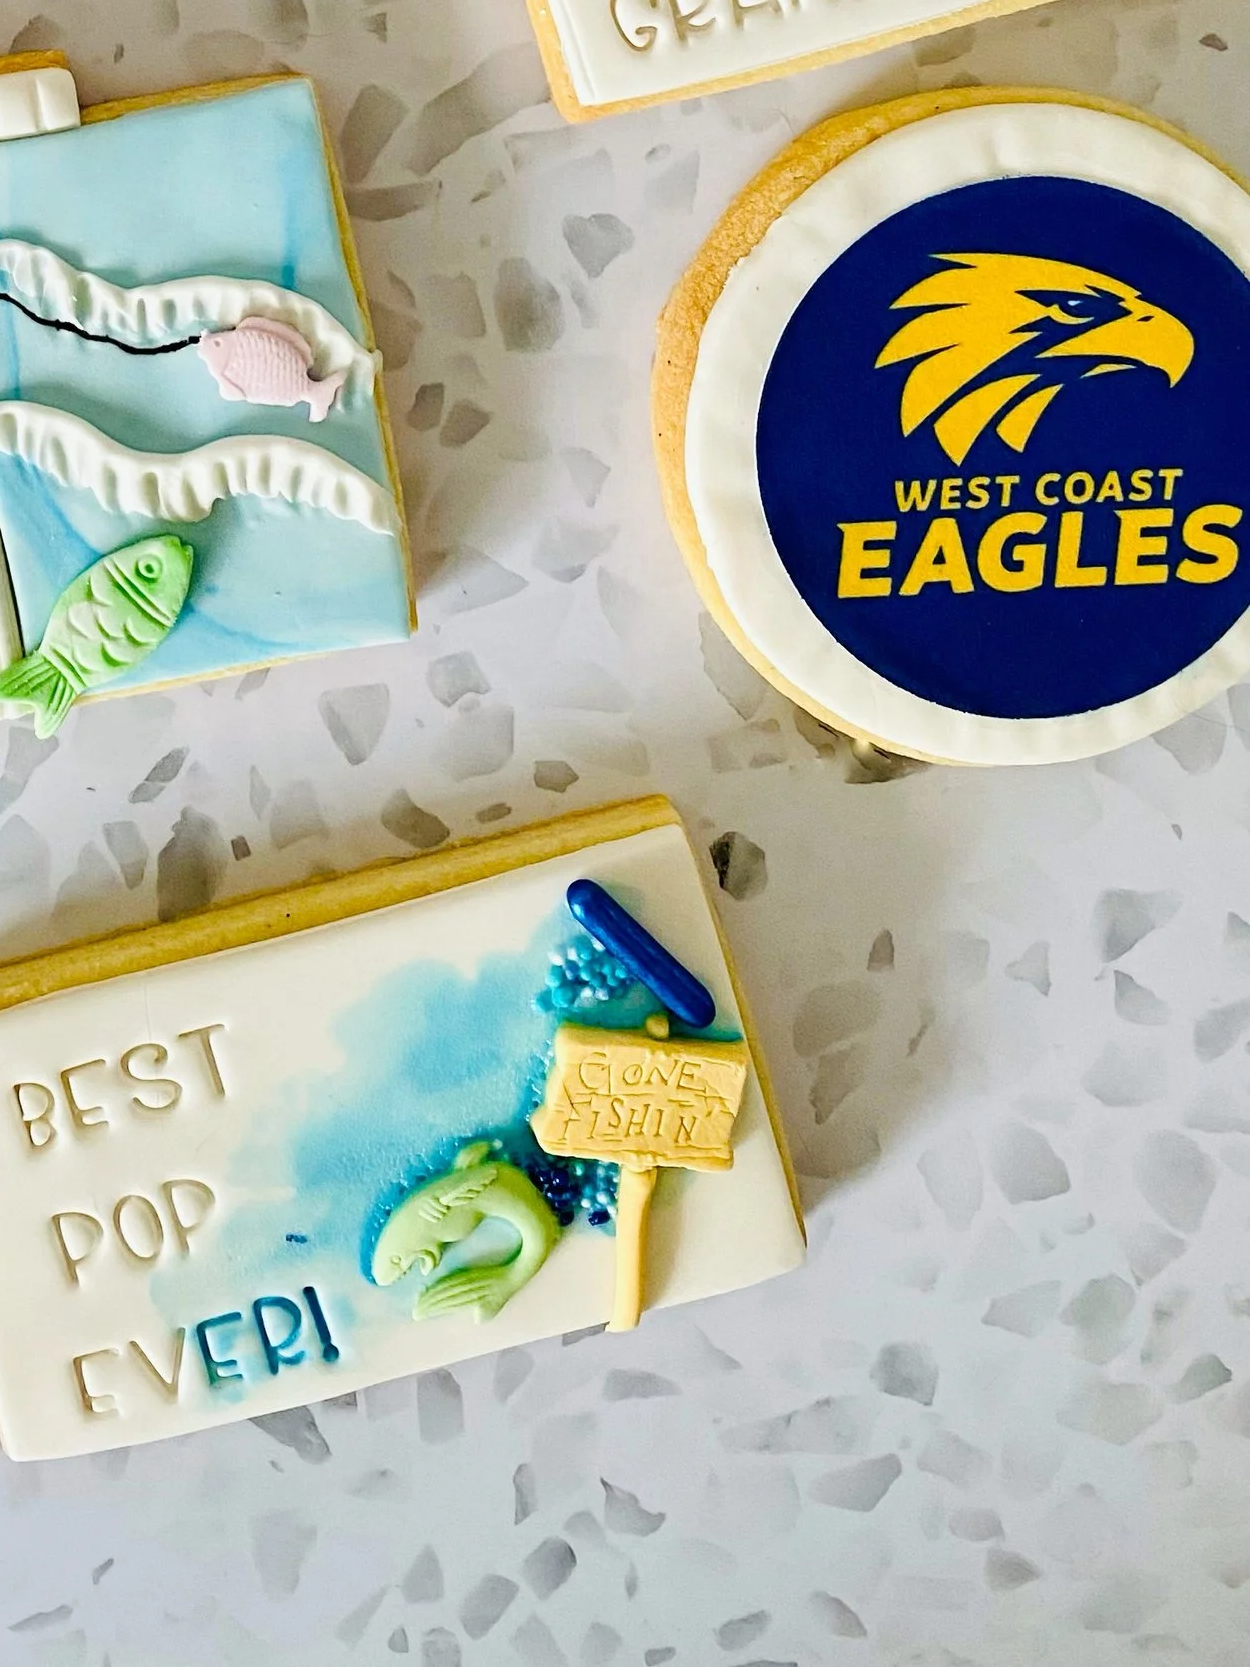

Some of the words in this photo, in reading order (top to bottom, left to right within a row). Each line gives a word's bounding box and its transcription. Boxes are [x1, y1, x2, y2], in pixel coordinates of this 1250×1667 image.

[895, 475, 1021, 512] WEST
[1035, 468, 1184, 506] COAST
[837, 503, 1243, 599] EAGLES
[13, 1024, 226, 1149] BEST
[578, 1052, 707, 1095] GONE
[51, 1179, 217, 1285] POP
[72, 1286, 340, 1415] EVER!
